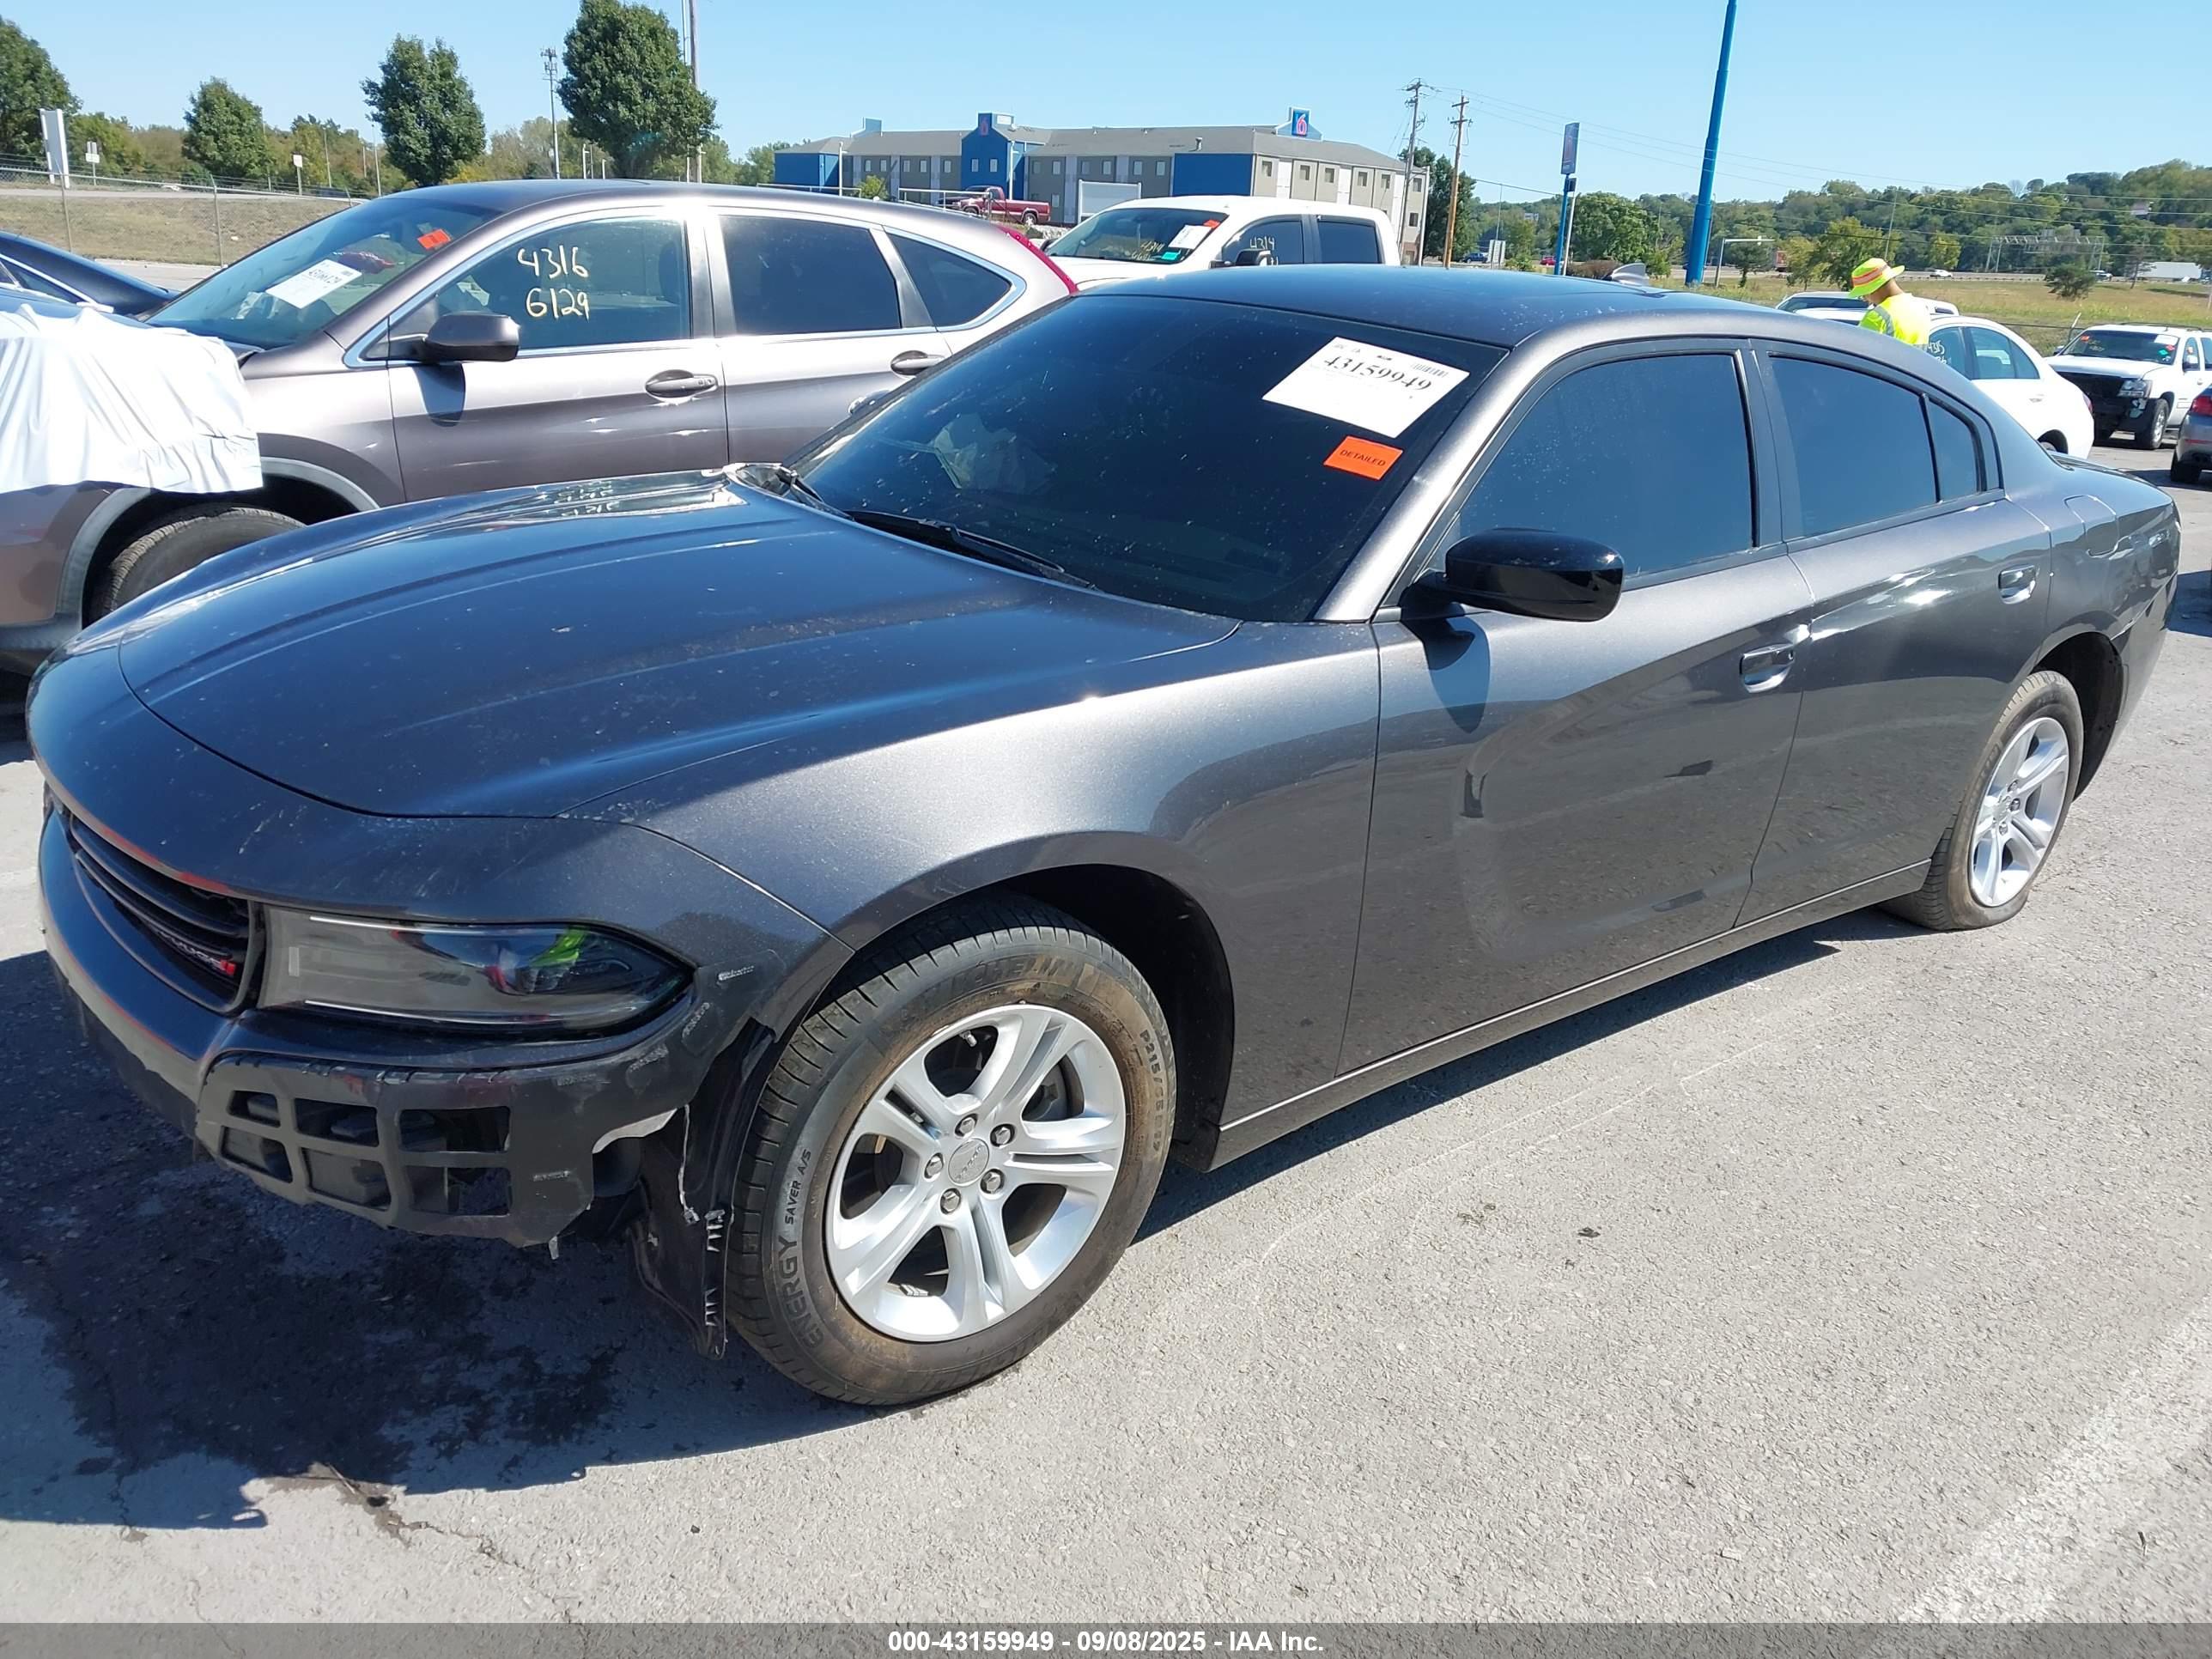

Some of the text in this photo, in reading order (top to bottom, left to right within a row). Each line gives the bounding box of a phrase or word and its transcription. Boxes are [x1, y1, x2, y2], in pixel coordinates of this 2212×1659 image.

[1249, 235, 1275, 251] 4314
[517, 245, 588, 279] 4316
[526, 288, 590, 322] 6129
[1324, 356, 1432, 391] 43159949
[1340, 449, 1387, 466] DETAILED
[778, 1148, 824, 1349] ENERGY SAVER A/S
